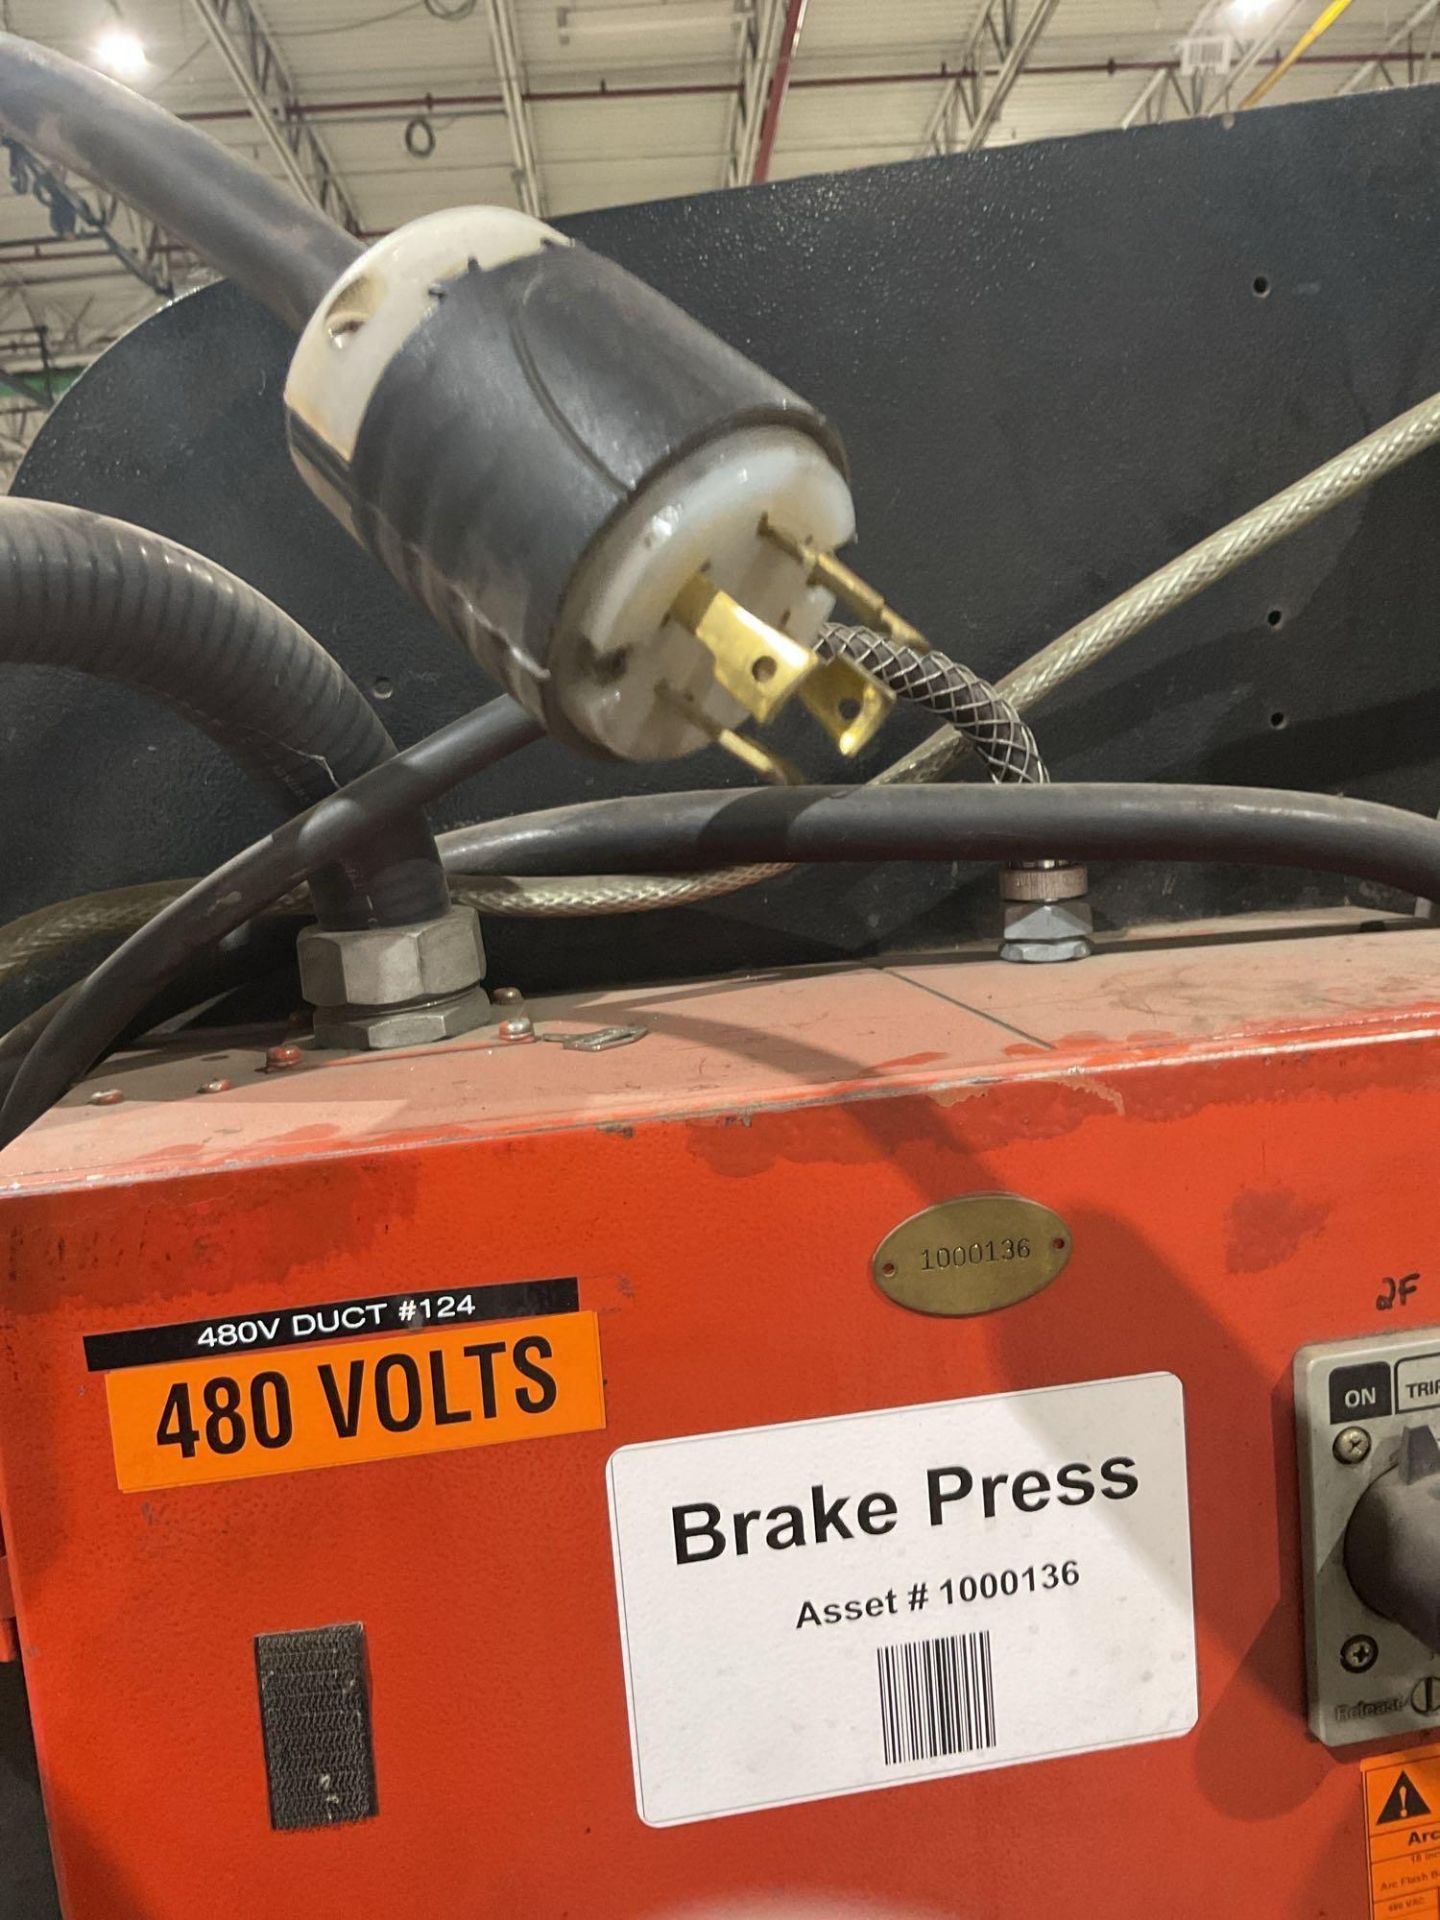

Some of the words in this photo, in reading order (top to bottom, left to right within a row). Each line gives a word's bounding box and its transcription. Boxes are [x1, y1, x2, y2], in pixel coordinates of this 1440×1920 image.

[920, 1238, 1031, 1271] 1000136
[197, 1317, 282, 1348] 480V
[292, 1303, 389, 1336] DUCT
[398, 1294, 477, 1322] #124
[156, 1371, 293, 1458] 480
[317, 1335, 558, 1439] VOLTS
[1344, 1386, 1377, 1408] ON
[671, 1485, 899, 1565] Brake
[927, 1456, 1140, 1526] Press
[795, 1587, 897, 1629] Asset
[908, 1583, 929, 1611] #
[939, 1560, 1081, 1605] 1000136
